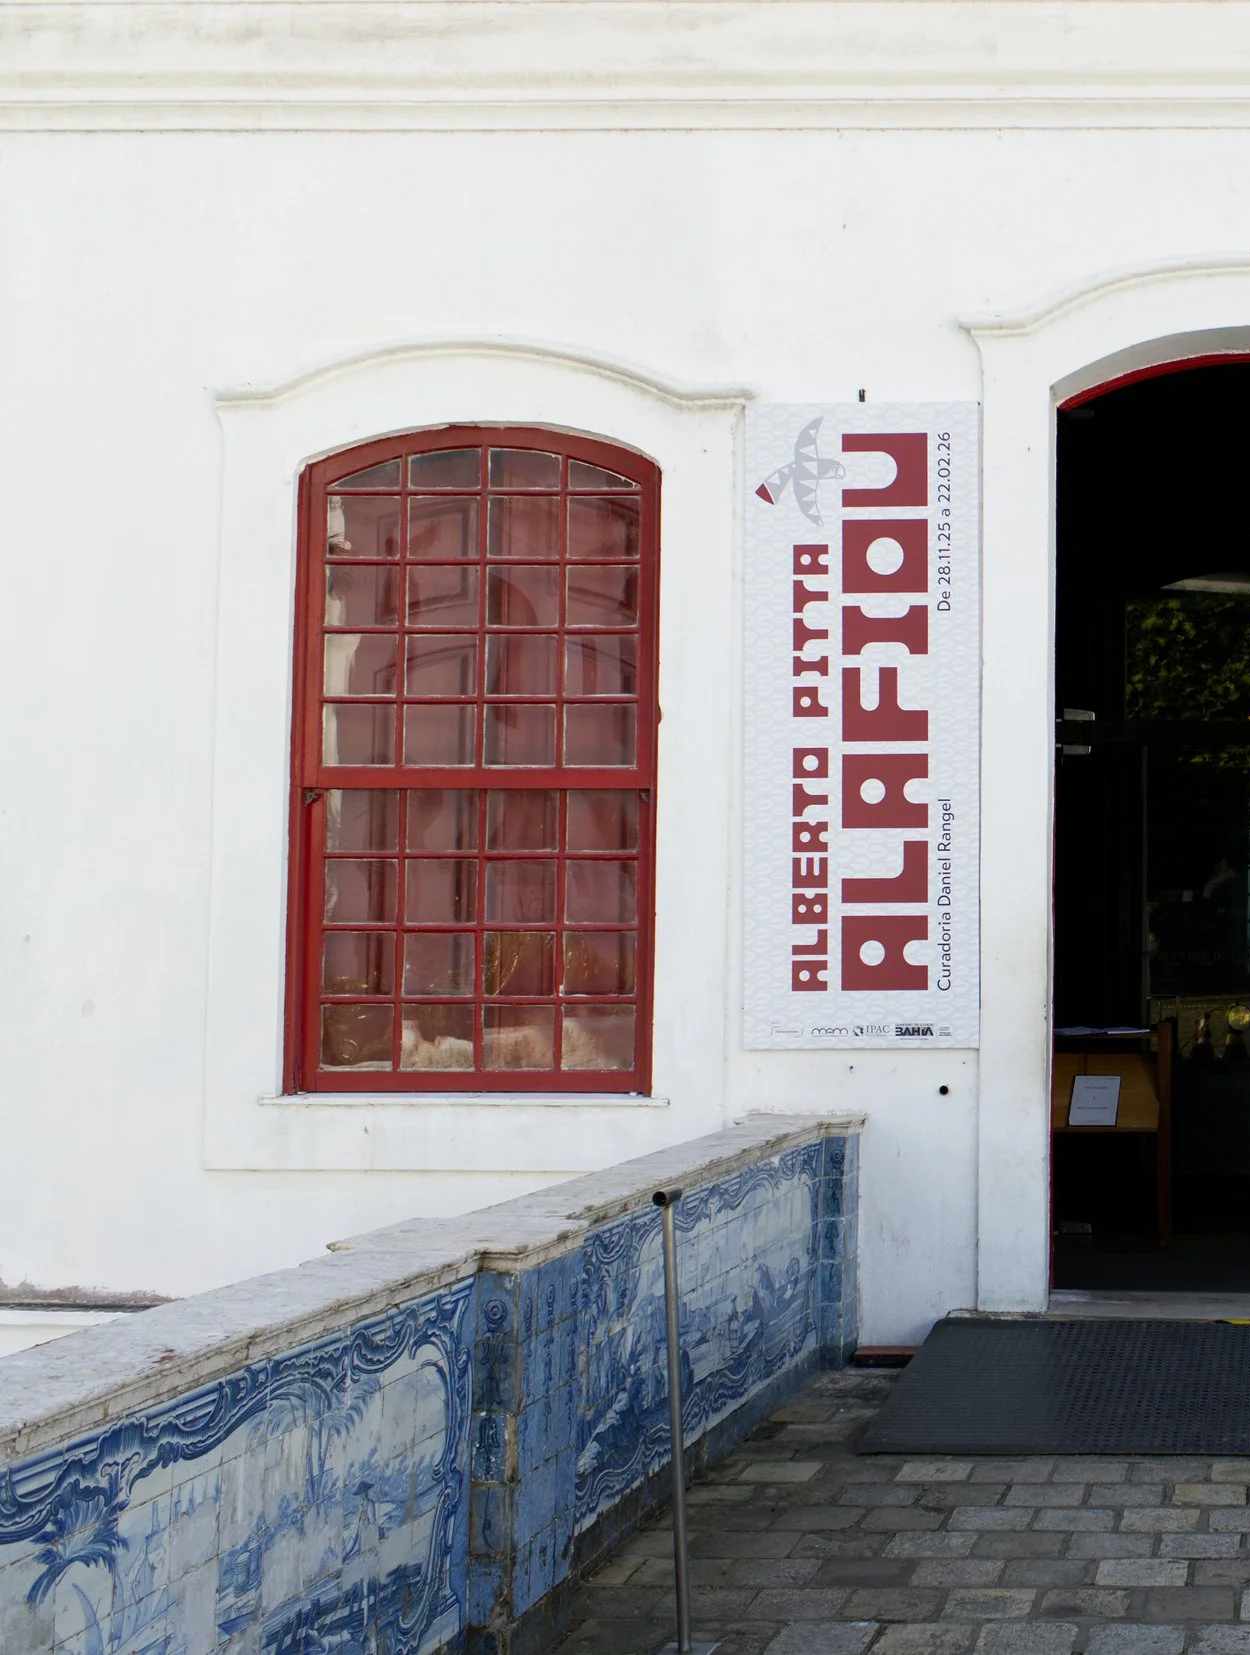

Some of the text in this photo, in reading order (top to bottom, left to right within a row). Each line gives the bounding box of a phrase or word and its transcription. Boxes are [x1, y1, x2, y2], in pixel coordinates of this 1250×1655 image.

[937, 433, 951, 611] De 28.11.25 a 22.02.26
[792, 545, 828, 991] ALBERTO PITTA
[842, 433, 928, 990] ALAFIOU
[937, 799, 956, 991] Curadoria Daniel Rangel
[866, 1025, 889, 1034] IPAC
